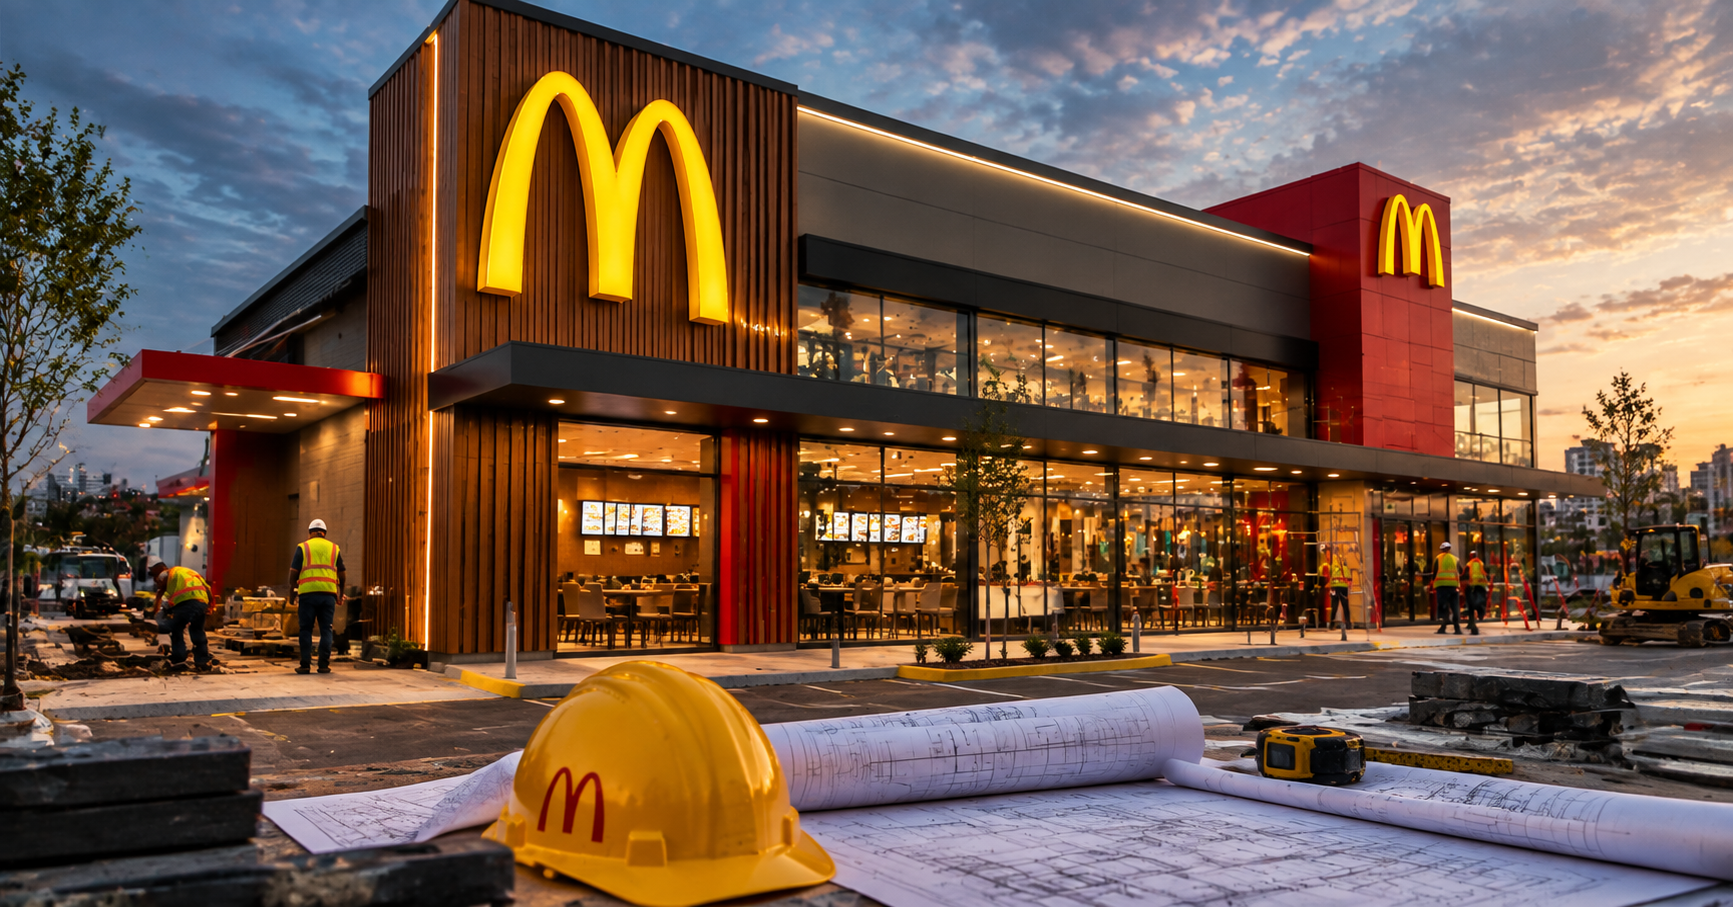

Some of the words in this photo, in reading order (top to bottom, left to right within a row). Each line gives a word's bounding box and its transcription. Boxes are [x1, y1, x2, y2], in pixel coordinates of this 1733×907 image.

[478, 71, 729, 325] M
[1378, 193, 1445, 288] M
[537, 767, 605, 843] M
